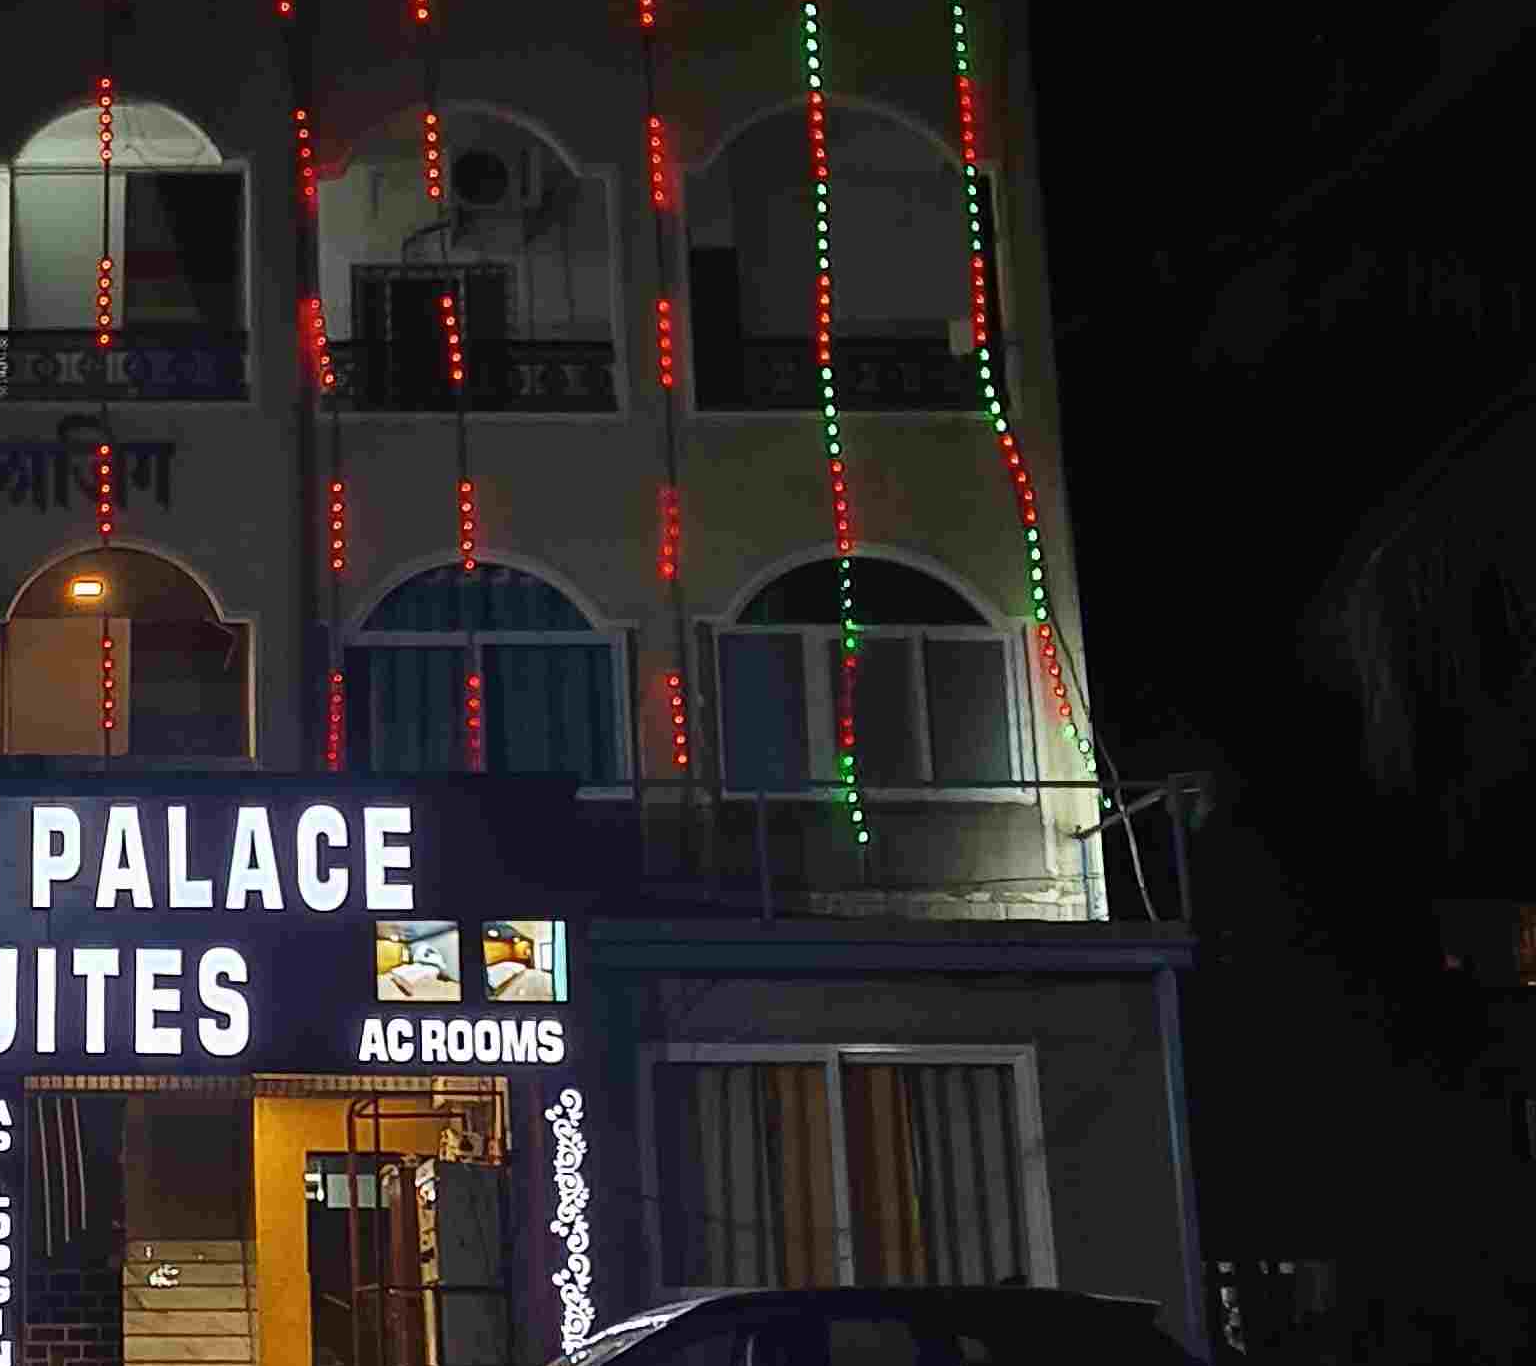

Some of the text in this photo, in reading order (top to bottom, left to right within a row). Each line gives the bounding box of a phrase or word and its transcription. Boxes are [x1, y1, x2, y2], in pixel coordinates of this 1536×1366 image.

[31, 803, 416, 911] PALACE
[357, 1017, 566, 1064] AC ROOMS
